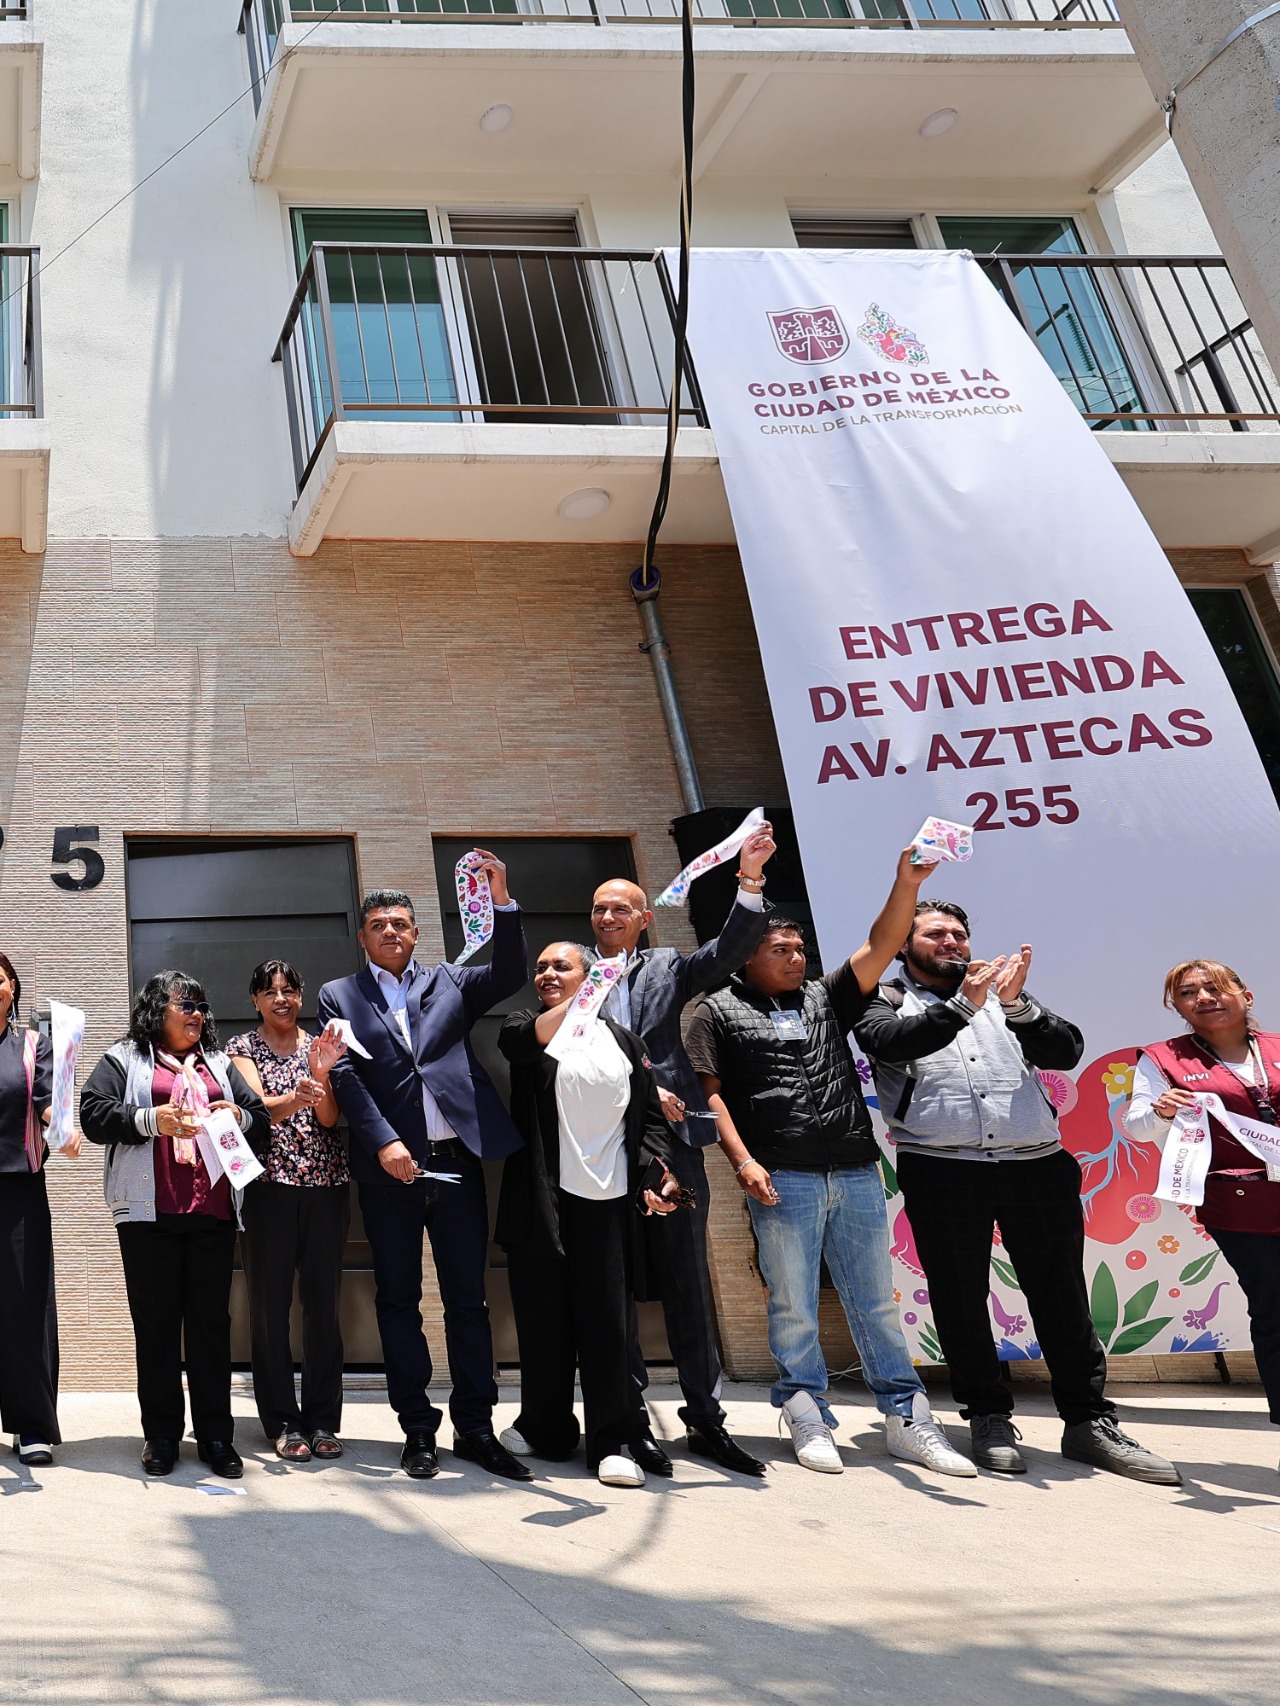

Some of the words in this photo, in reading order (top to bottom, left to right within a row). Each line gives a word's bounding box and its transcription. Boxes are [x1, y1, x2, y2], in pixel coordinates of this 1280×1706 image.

[748, 370, 901, 397] GOBIERNO
[910, 371, 952, 386] DE
[960, 368, 1000, 382] LA
[754, 394, 855, 417] CIUDAD
[862, 389, 902, 407] DE
[906, 386, 1011, 404] MÉXICO
[759, 424, 819, 435] CAPITAL
[822, 417, 847, 433] DE
[851, 415, 872, 426] LA
[872, 403, 1024, 423] TRANSFORMACIÓN
[838, 599, 1114, 660] ENTREGA
[808, 680, 884, 723] DE
[889, 650, 1186, 713] VIVIENDA
[817, 738, 908, 785] AV.
[926, 708, 1213, 772] AZTECAS
[965, 784, 1080, 832] 255
[1182, 1072, 1210, 1082] INVI
[1172, 1148, 1189, 1176] MÉXICO
[1172, 1176, 1182, 1188] DE
